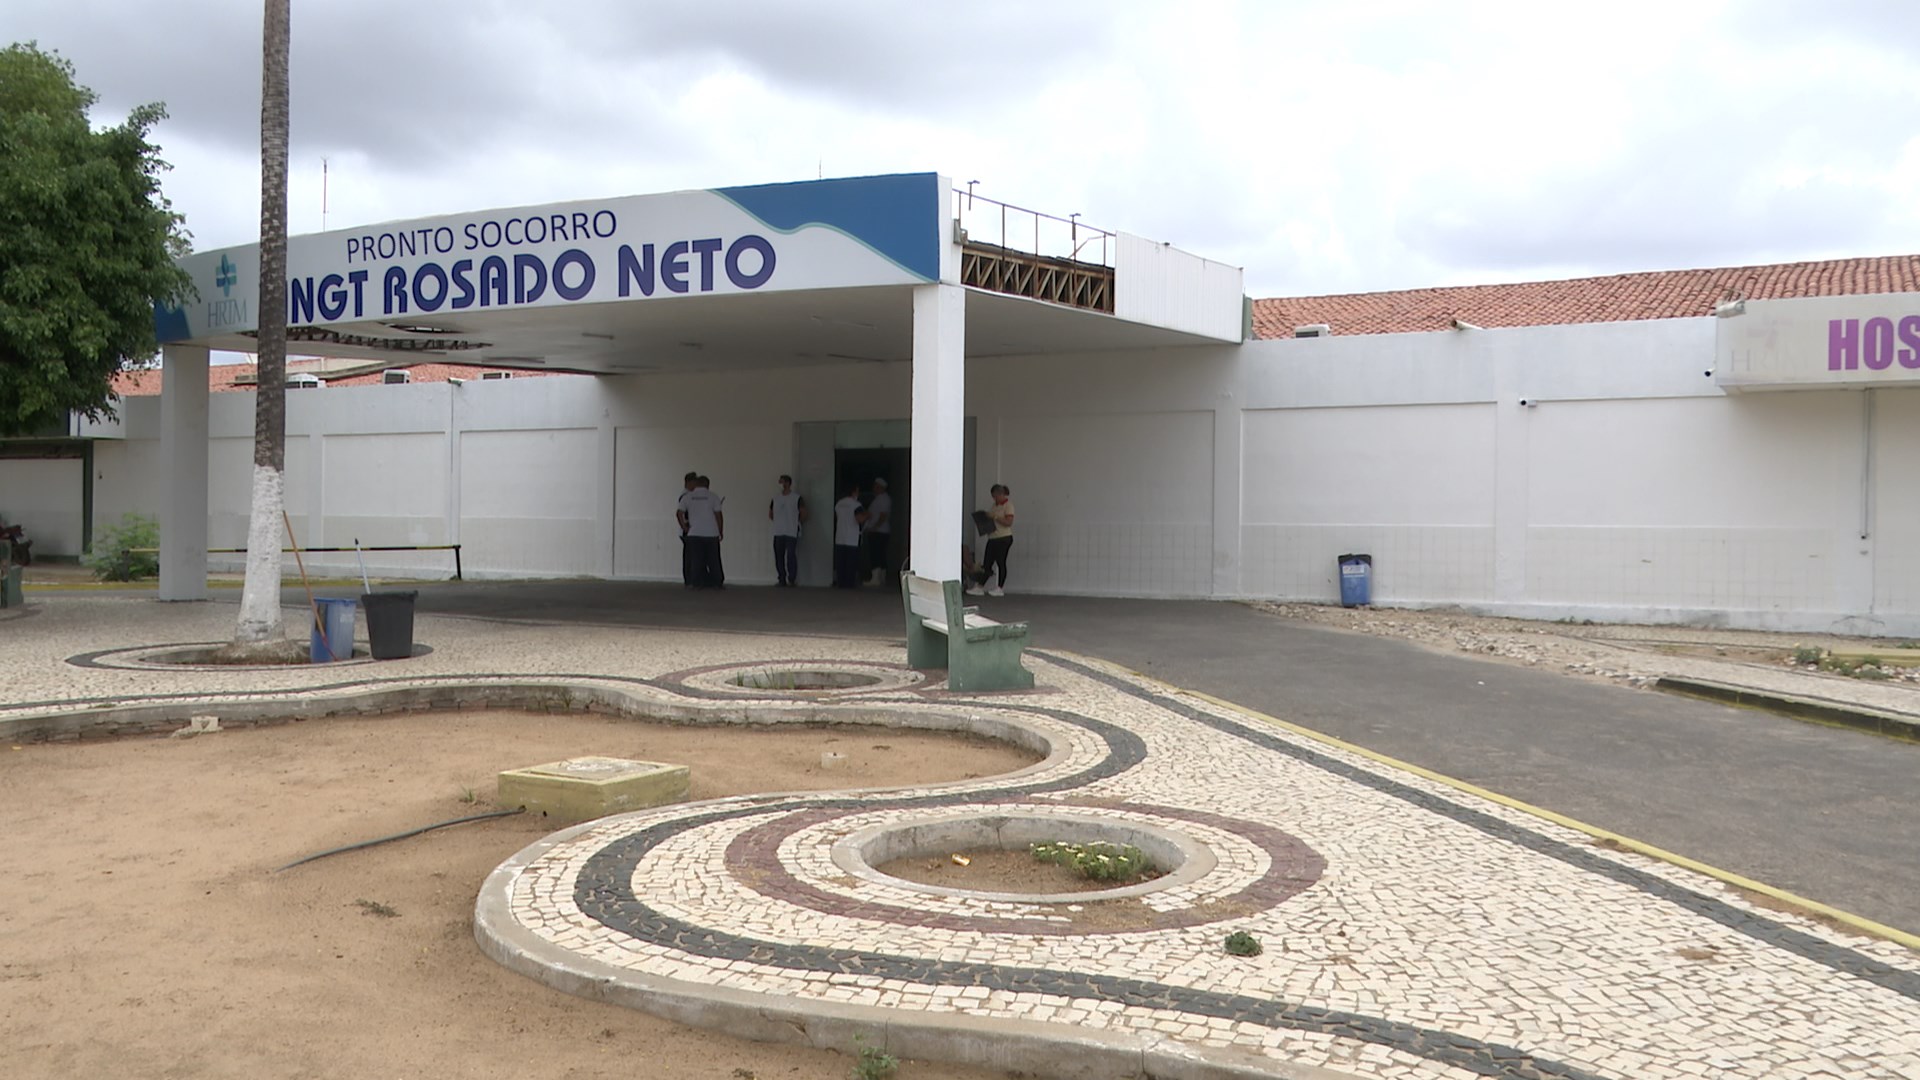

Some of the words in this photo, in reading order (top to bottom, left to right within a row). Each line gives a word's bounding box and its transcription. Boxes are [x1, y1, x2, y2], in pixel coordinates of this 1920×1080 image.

[347, 226, 454, 263] PRONTO
[464, 209, 617, 250] SOCORRO
[384, 248, 596, 315] ROSADO
[617, 234, 777, 298] NETO
[1828, 316, 1920, 371] HOS
